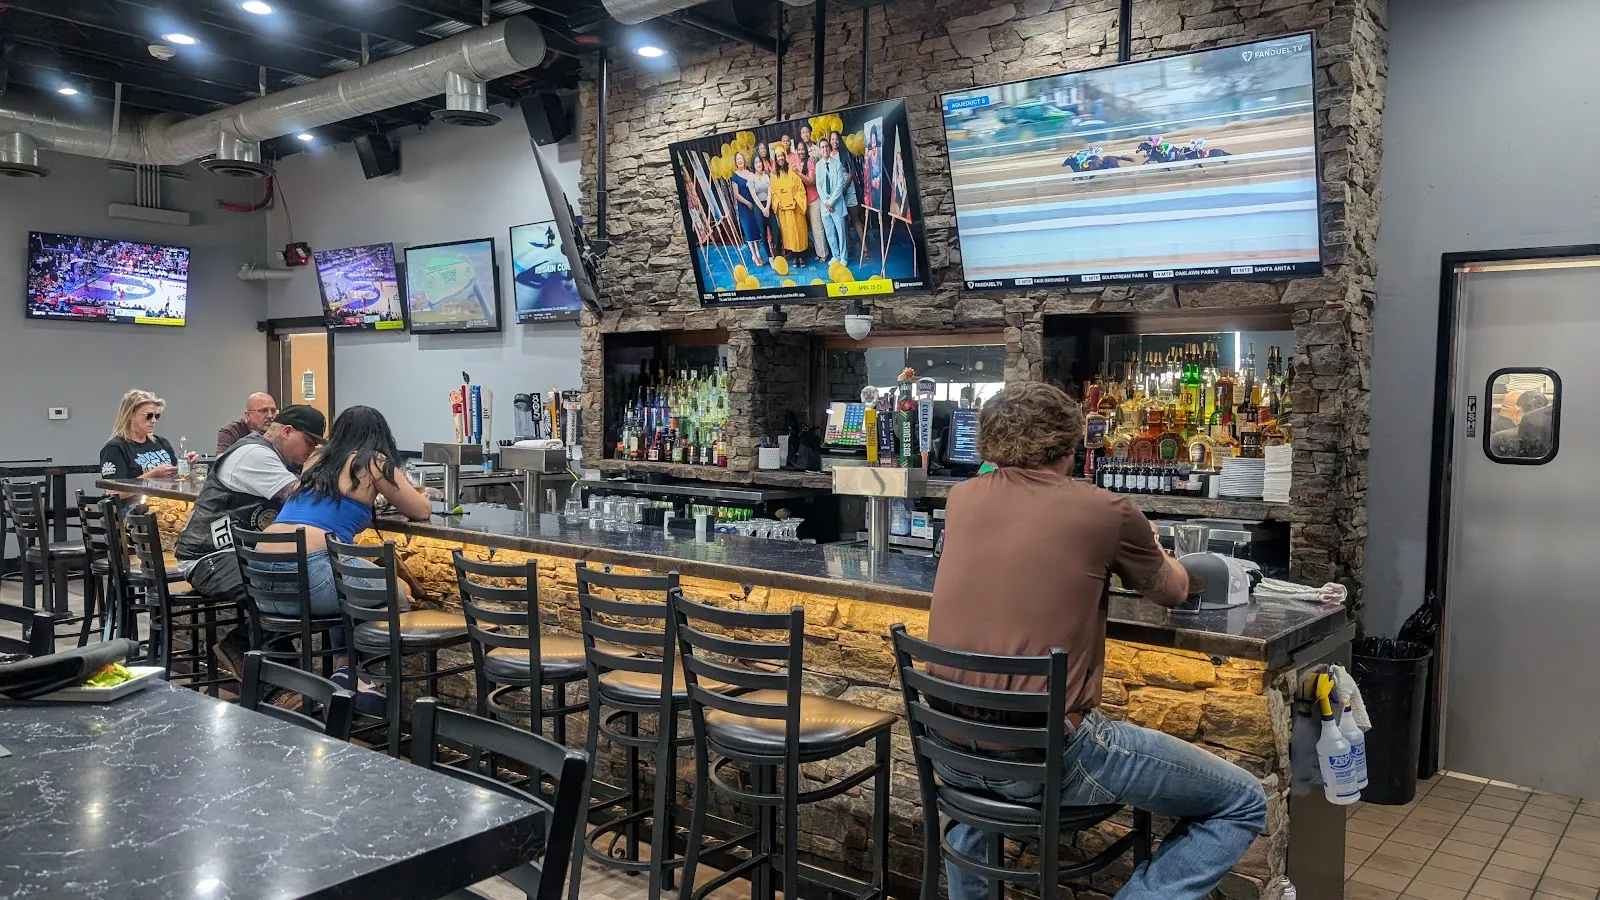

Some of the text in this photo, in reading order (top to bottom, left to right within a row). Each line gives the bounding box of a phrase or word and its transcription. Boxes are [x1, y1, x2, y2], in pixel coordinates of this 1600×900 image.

[1254, 44, 1303, 58] FANDUEL TV
[951, 98, 980, 108] AQUEDUCT
[531, 394, 541, 419] 805
[1467, 398, 1476, 429] PUSH
[880, 414, 888, 445] KILT
[902, 421, 911, 457] DOS EQUIS
[921, 423, 929, 443] SNAP
